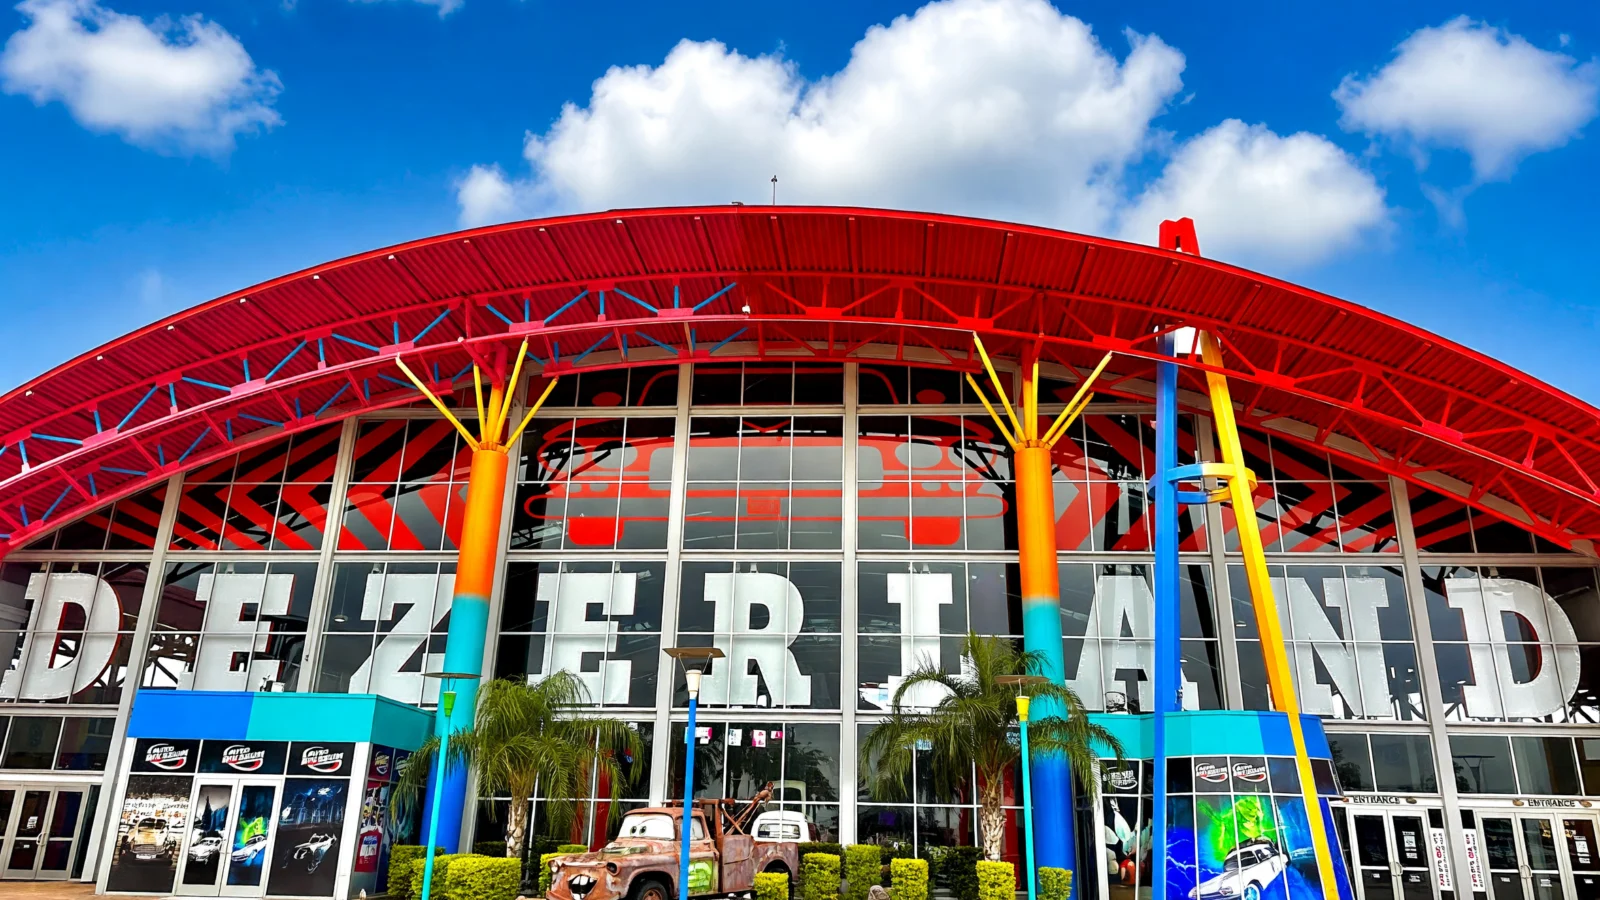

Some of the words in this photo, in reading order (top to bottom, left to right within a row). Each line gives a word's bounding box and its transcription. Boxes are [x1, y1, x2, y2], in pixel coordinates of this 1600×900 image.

[0, 570, 1581, 719] DEZERLAND
[1352, 795, 1401, 804] ENTRANCE
[1527, 798, 1576, 807] ENTRANCE
